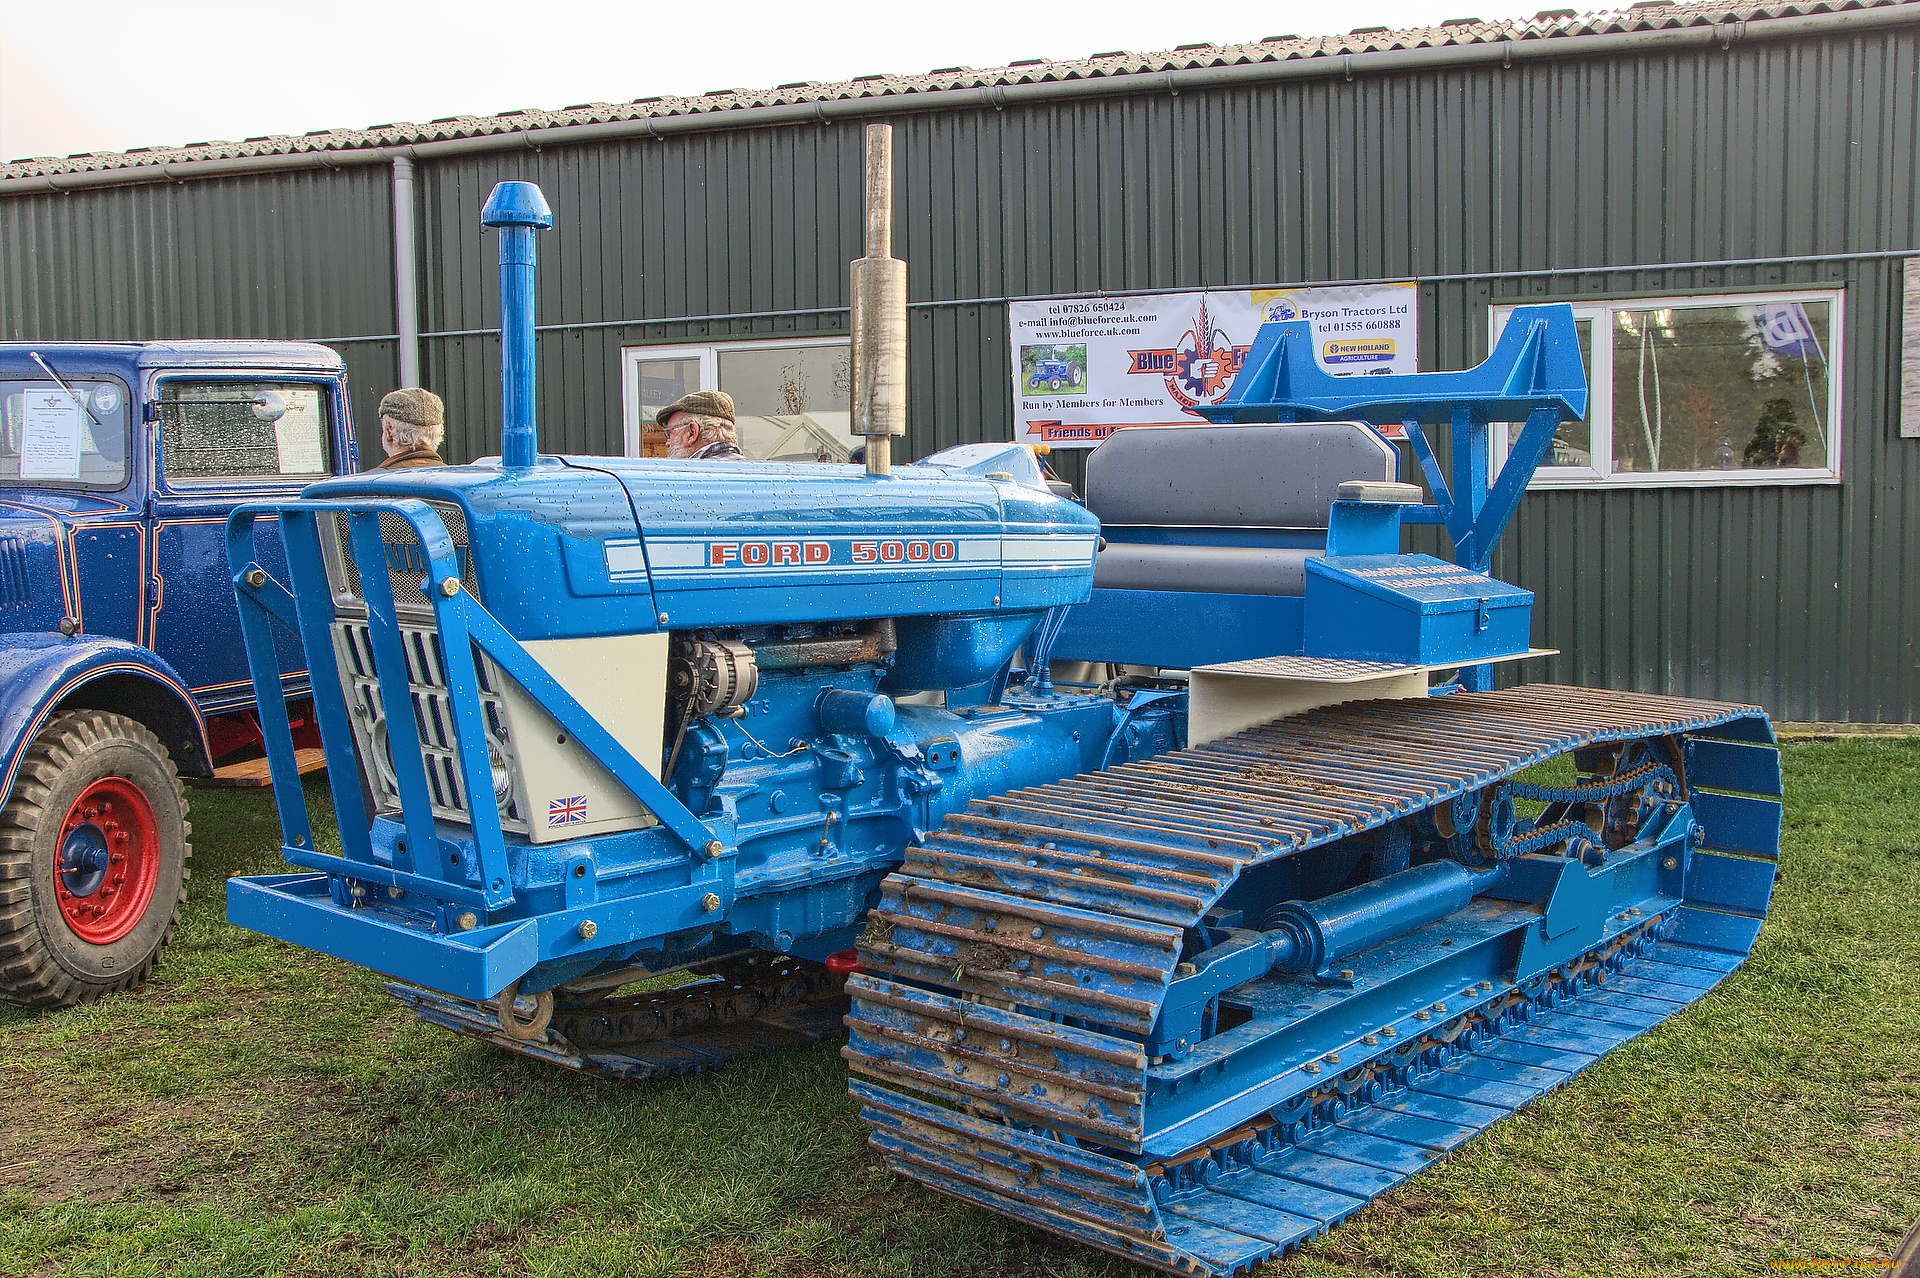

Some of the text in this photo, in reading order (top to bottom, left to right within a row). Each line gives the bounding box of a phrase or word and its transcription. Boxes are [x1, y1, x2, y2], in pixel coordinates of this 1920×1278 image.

[1049, 302, 1125, 314] tel 07826 650424
[1301, 304, 1408, 320] Bryson Tractors Ltd
[1018, 314, 1157, 327] e-mail info@blueforce.uk.com
[1318, 320, 1401, 332] tel 01555 660888
[1036, 327, 1141, 338] www.blueforce.uk.com
[1357, 344, 1390, 352] HOLLAND
[1137, 353, 1175, 370] Blue
[1169, 384, 1196, 407] MAJOR
[1022, 398, 1164, 411] Run by Members for Members
[1049, 427, 1091, 438] Friends
[1095, 427, 1108, 437] of
[710, 540, 955, 567] FORD 5000
